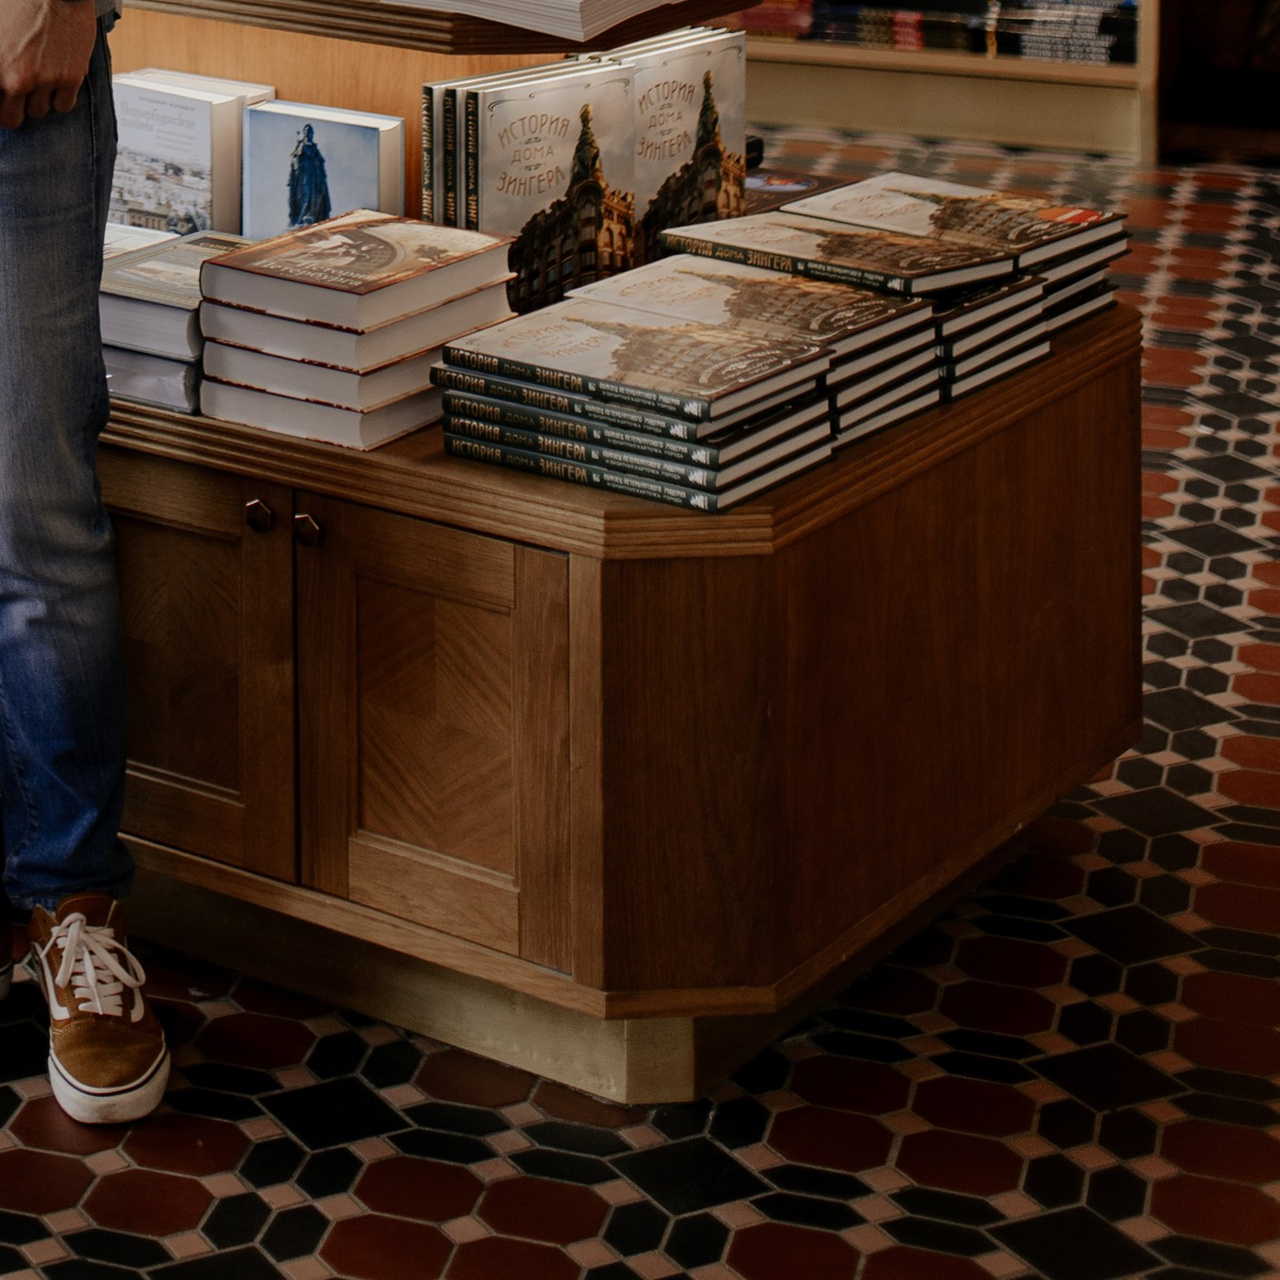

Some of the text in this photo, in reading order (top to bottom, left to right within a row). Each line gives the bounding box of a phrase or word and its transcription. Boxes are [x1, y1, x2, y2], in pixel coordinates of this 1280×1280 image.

[637, 81, 695, 115] ИСТОРИЯ
[497, 114, 570, 149] ИСТОРИЯ
[648, 111, 683, 130] ДОМА
[511, 146, 554, 165] ДОМА
[637, 130, 692, 161] ЗИНГЕРА
[496, 166, 567, 196] ЗИНГЕРА
[666, 236, 793, 272] ИСТОРИЯ ДОМА ЗИНГЕРА
[450, 348, 584, 392] ИСТОРИЯ ДОМА ЗИНГЕРА
[437, 368, 569, 413] ИСТОРИЯ ДОМА ЗИНГЕРА
[451, 398, 588, 440] ИСТОРИЯ ДОМА ЗИНГЕРА
[450, 417, 586, 461] ИСТОРИЯ ДОМА ЗИНГЕРА
[452, 440, 502, 462] ИСТОРИЯ
[506, 454, 535, 468] ДОМА
[539, 459, 588, 483] ЗИНГЕРА
